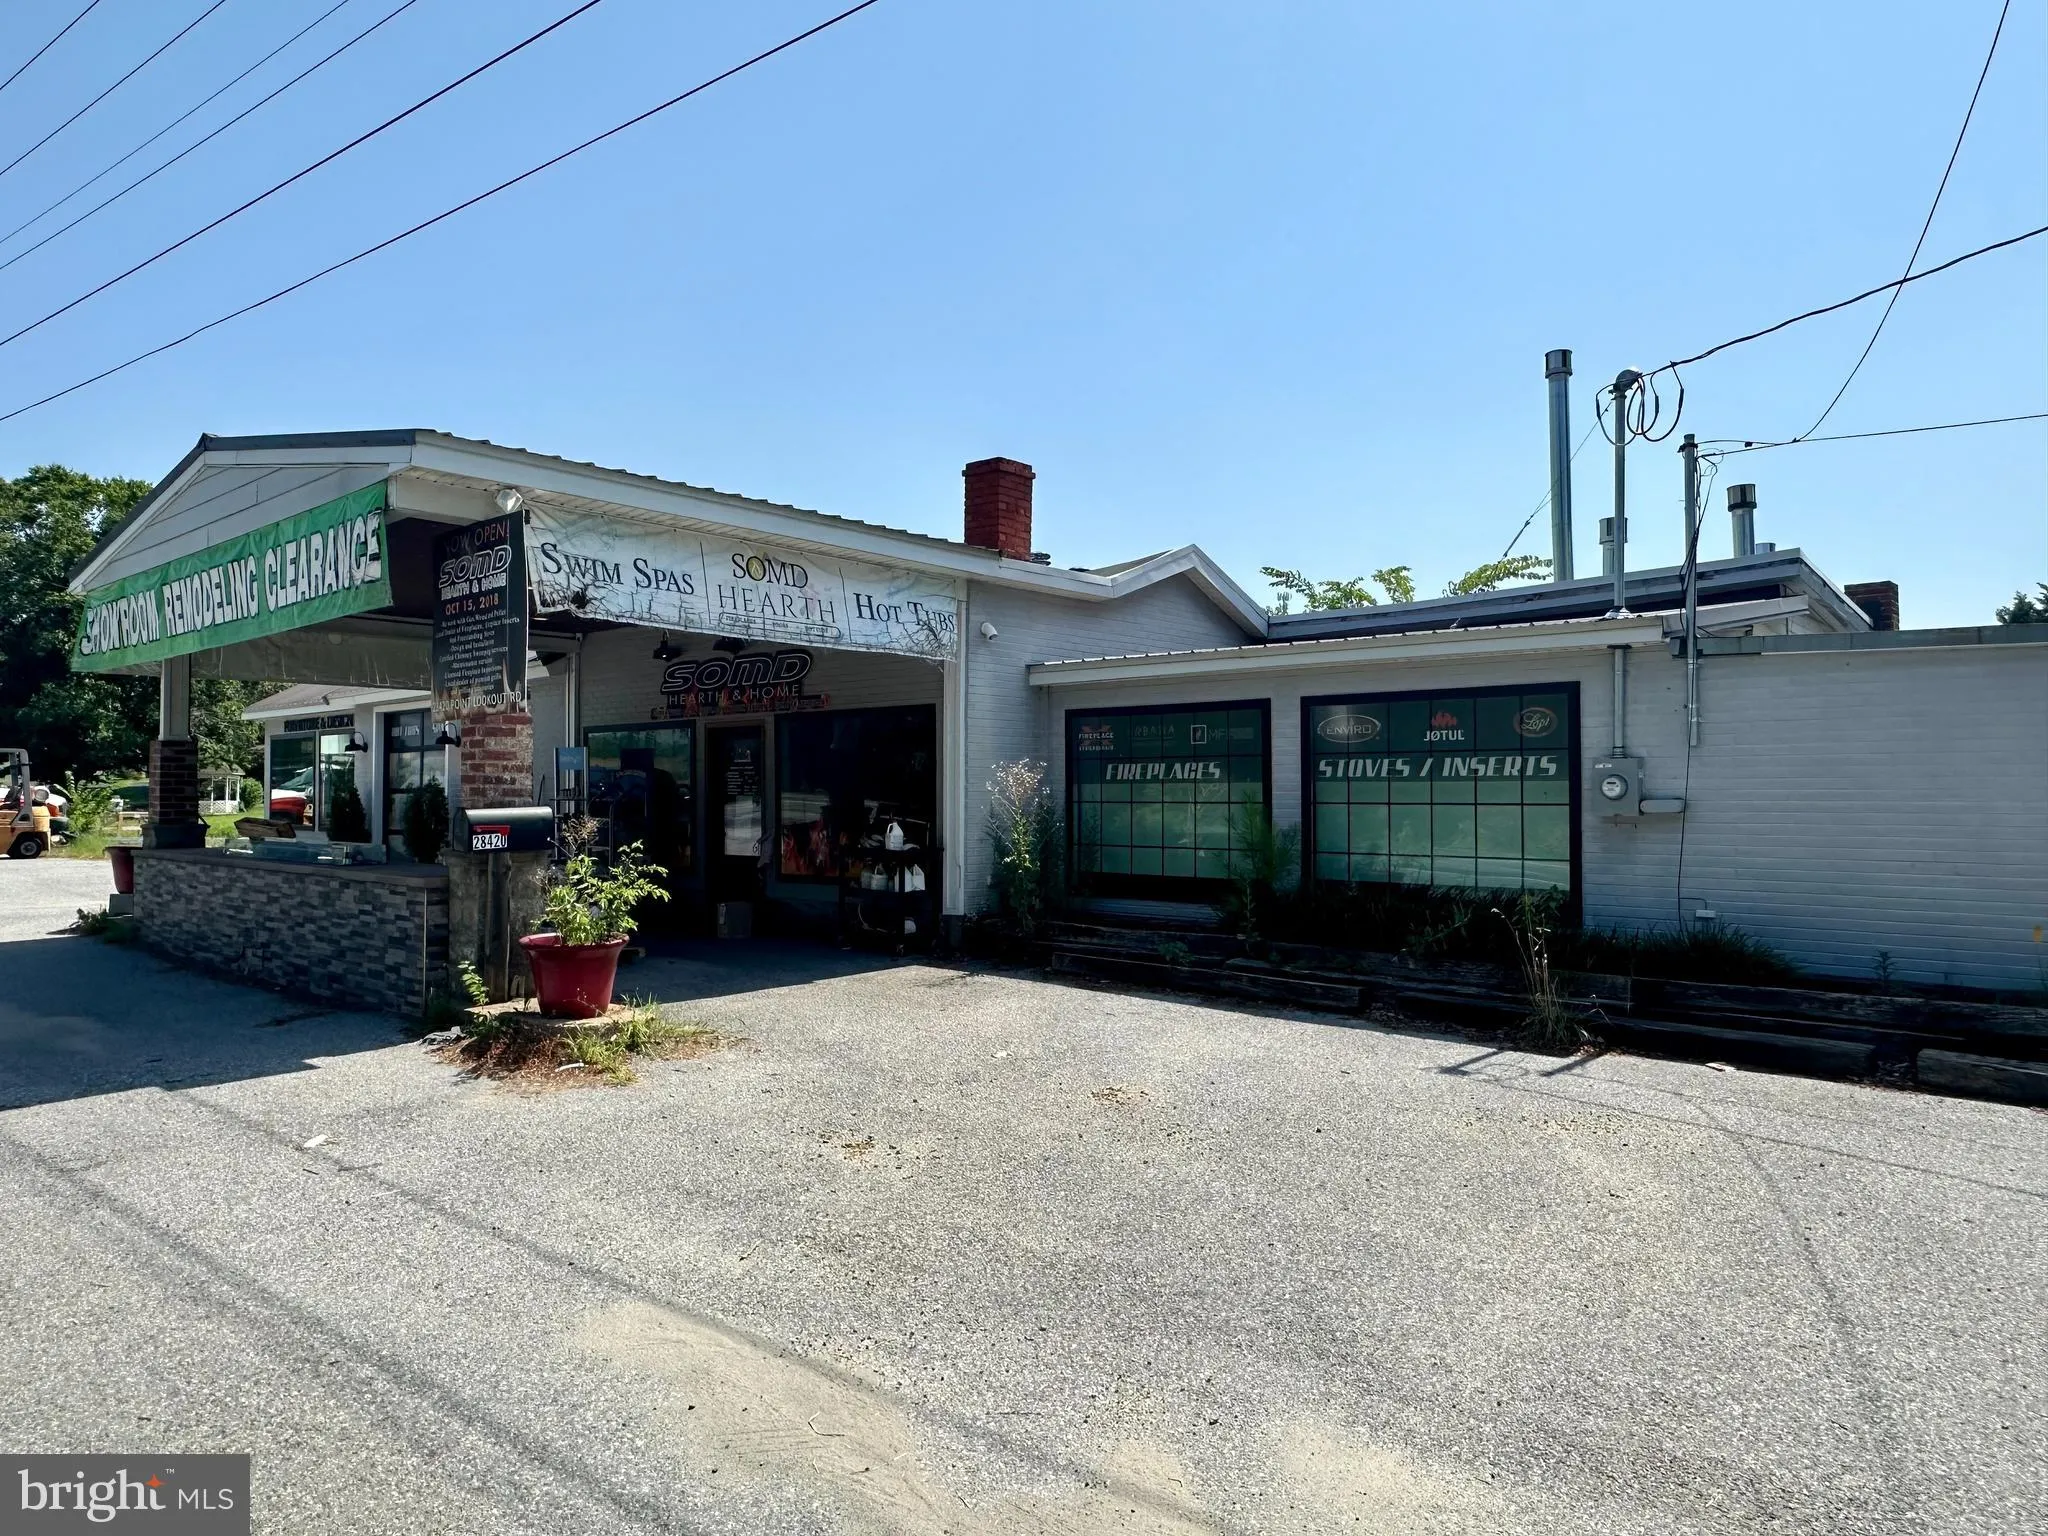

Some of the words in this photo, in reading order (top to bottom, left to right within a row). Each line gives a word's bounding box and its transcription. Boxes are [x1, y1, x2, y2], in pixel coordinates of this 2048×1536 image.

[438, 544, 512, 589] SOMD
[731, 553, 808, 589] SOMD
[80, 590, 160, 656] SHOWROOM
[162, 555, 258, 638] REMODELING
[264, 509, 382, 612] CLEARANCE
[445, 602, 460, 616] OCT
[717, 583, 836, 624] HEARTH
[661, 653, 811, 692] SOMD
[473, 692, 507, 708] LOOKOUT
[510, 690, 522, 703] RD
[668, 690, 725, 706] HEARTH
[732, 689, 741, 701] &
[749, 684, 800, 701] HOME
[1326, 724, 1372, 736] ENVIRO
[1105, 761, 1221, 780] FIREPLACES
[1318, 757, 1411, 778] STOVES
[1419, 758, 1433, 778] /
[1442, 755, 1558, 777] INSERTS
[473, 835, 507, 849] 28420
